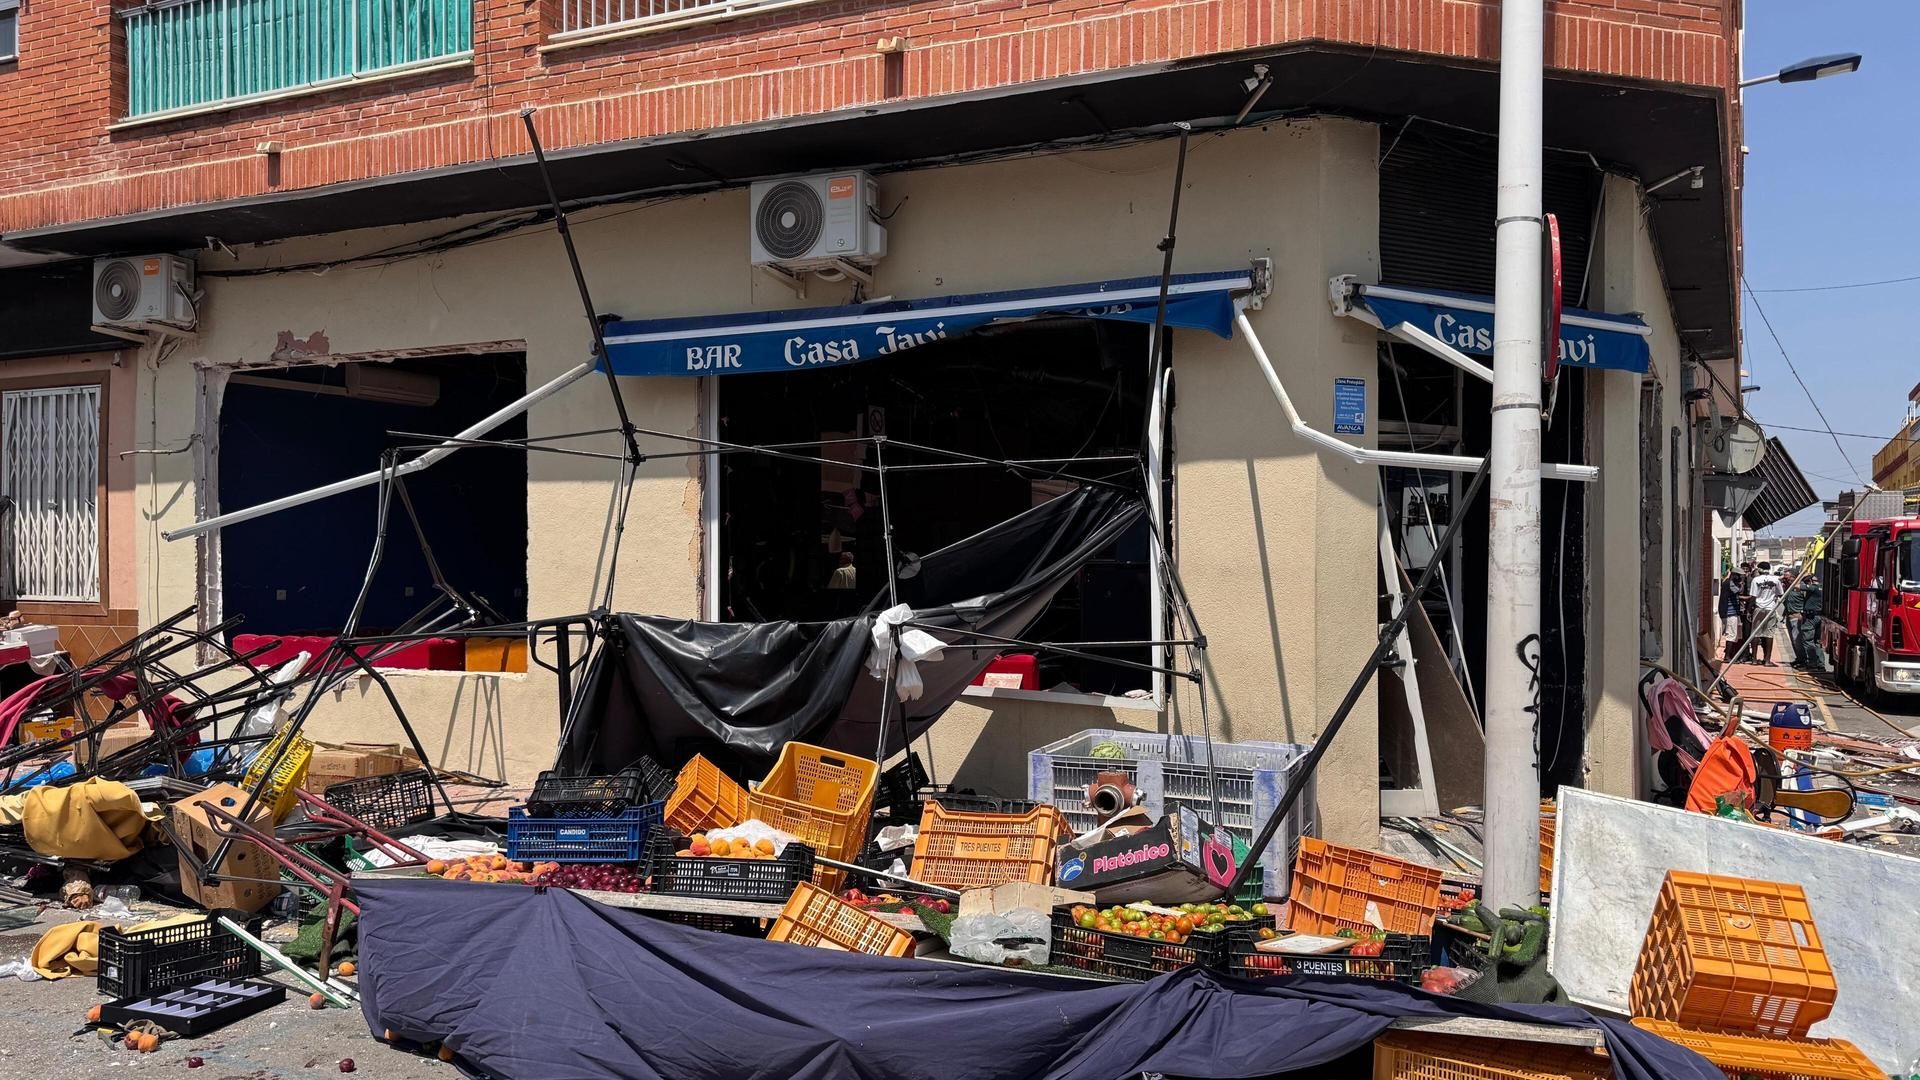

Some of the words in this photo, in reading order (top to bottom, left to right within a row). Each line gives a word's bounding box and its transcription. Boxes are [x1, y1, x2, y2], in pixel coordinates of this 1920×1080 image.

[686, 345, 742, 371] BAR
[784, 336, 860, 367] Casa
[875, 321, 948, 355] Javi
[1433, 313, 1496, 352] Cas
[1556, 334, 1596, 364] avi
[960, 842, 976, 852] TRES
[976, 842, 1001, 853] PUENTES
[1093, 843, 1170, 874] Platónico
[1296, 960, 1302, 969] 3
[1303, 961, 1343, 972] PUENTES
